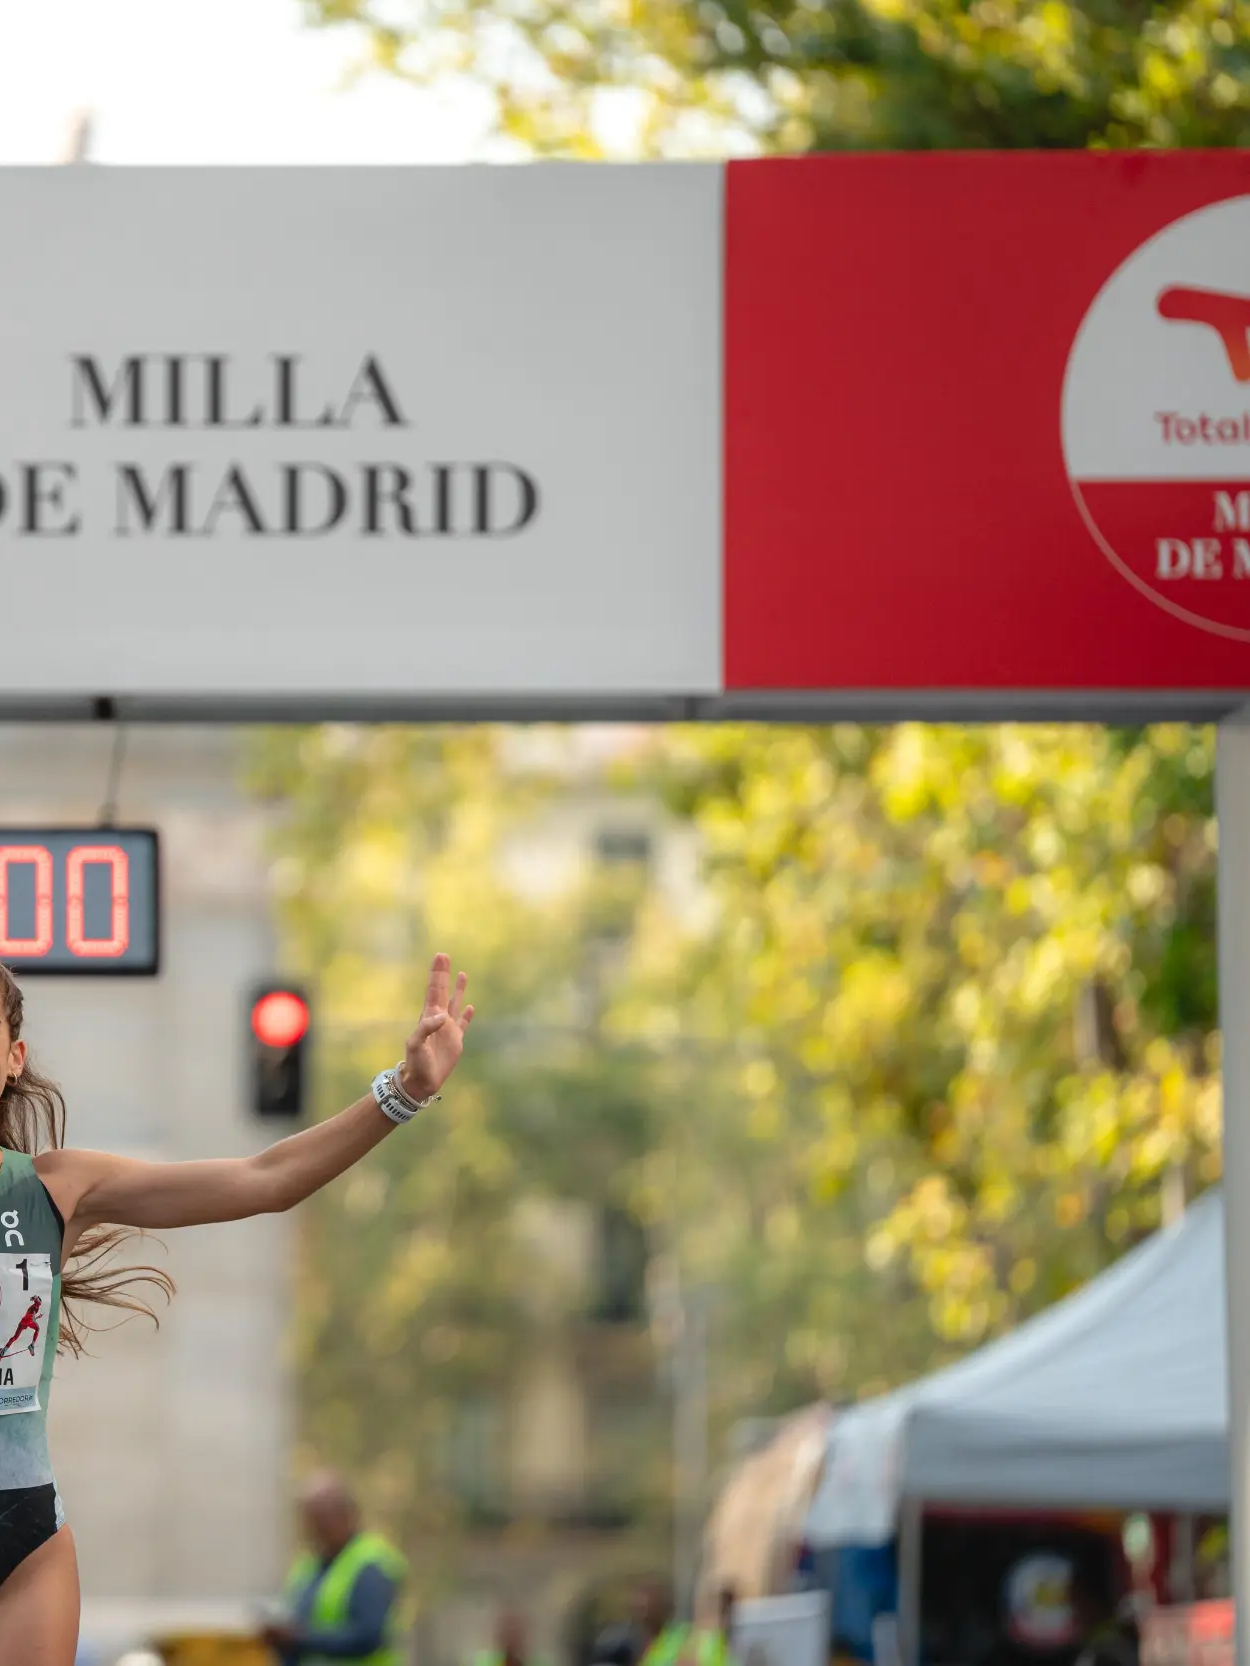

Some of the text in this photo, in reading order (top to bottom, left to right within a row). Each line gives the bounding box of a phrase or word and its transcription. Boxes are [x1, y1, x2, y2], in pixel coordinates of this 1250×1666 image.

[67, 351, 412, 429] MILLA
[112, 459, 542, 539] MADRID
[1156, 537, 1223, 580] DE
[16, 1259, 29, 1291] 1
